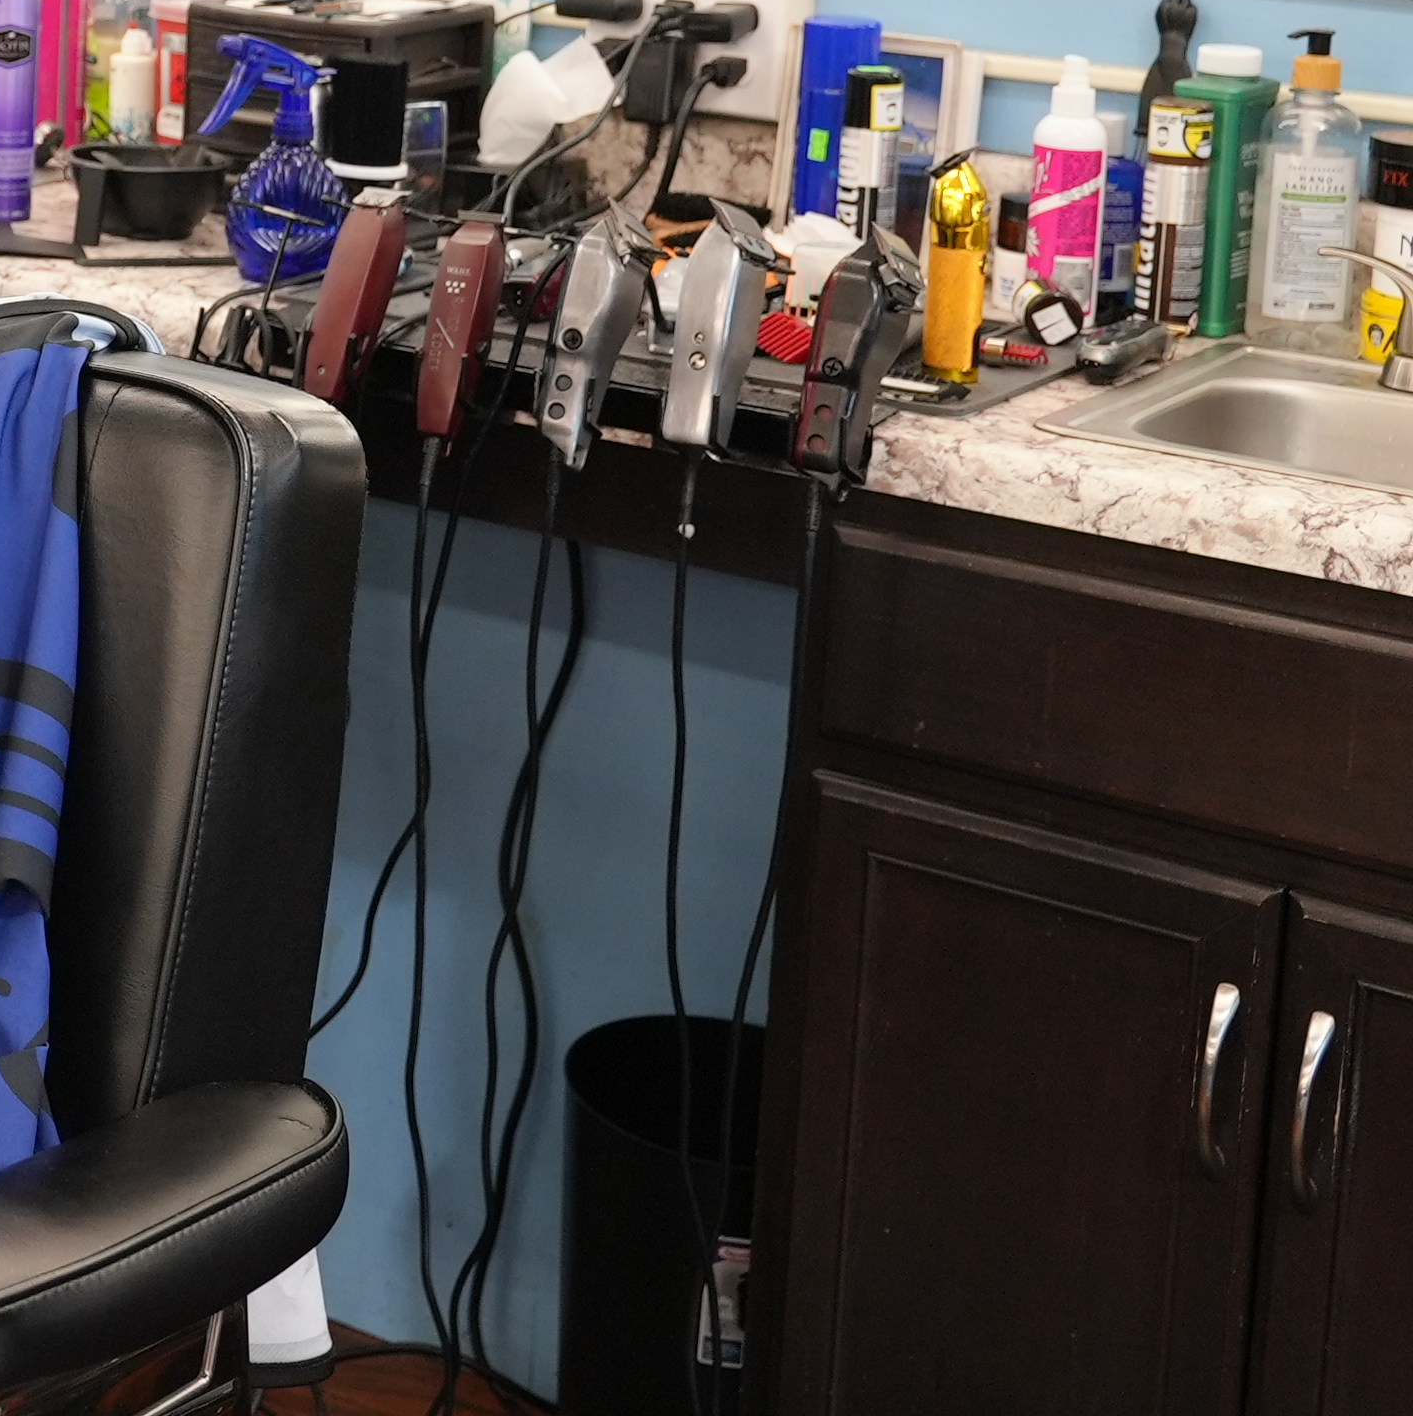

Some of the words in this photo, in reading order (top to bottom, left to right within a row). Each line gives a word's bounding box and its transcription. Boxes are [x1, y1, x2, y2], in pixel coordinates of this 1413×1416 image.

[1299, 175, 1334, 184] HAND
[1382, 168, 1410, 188] FIX
[1284, 181, 1345, 194] SANITIZER
